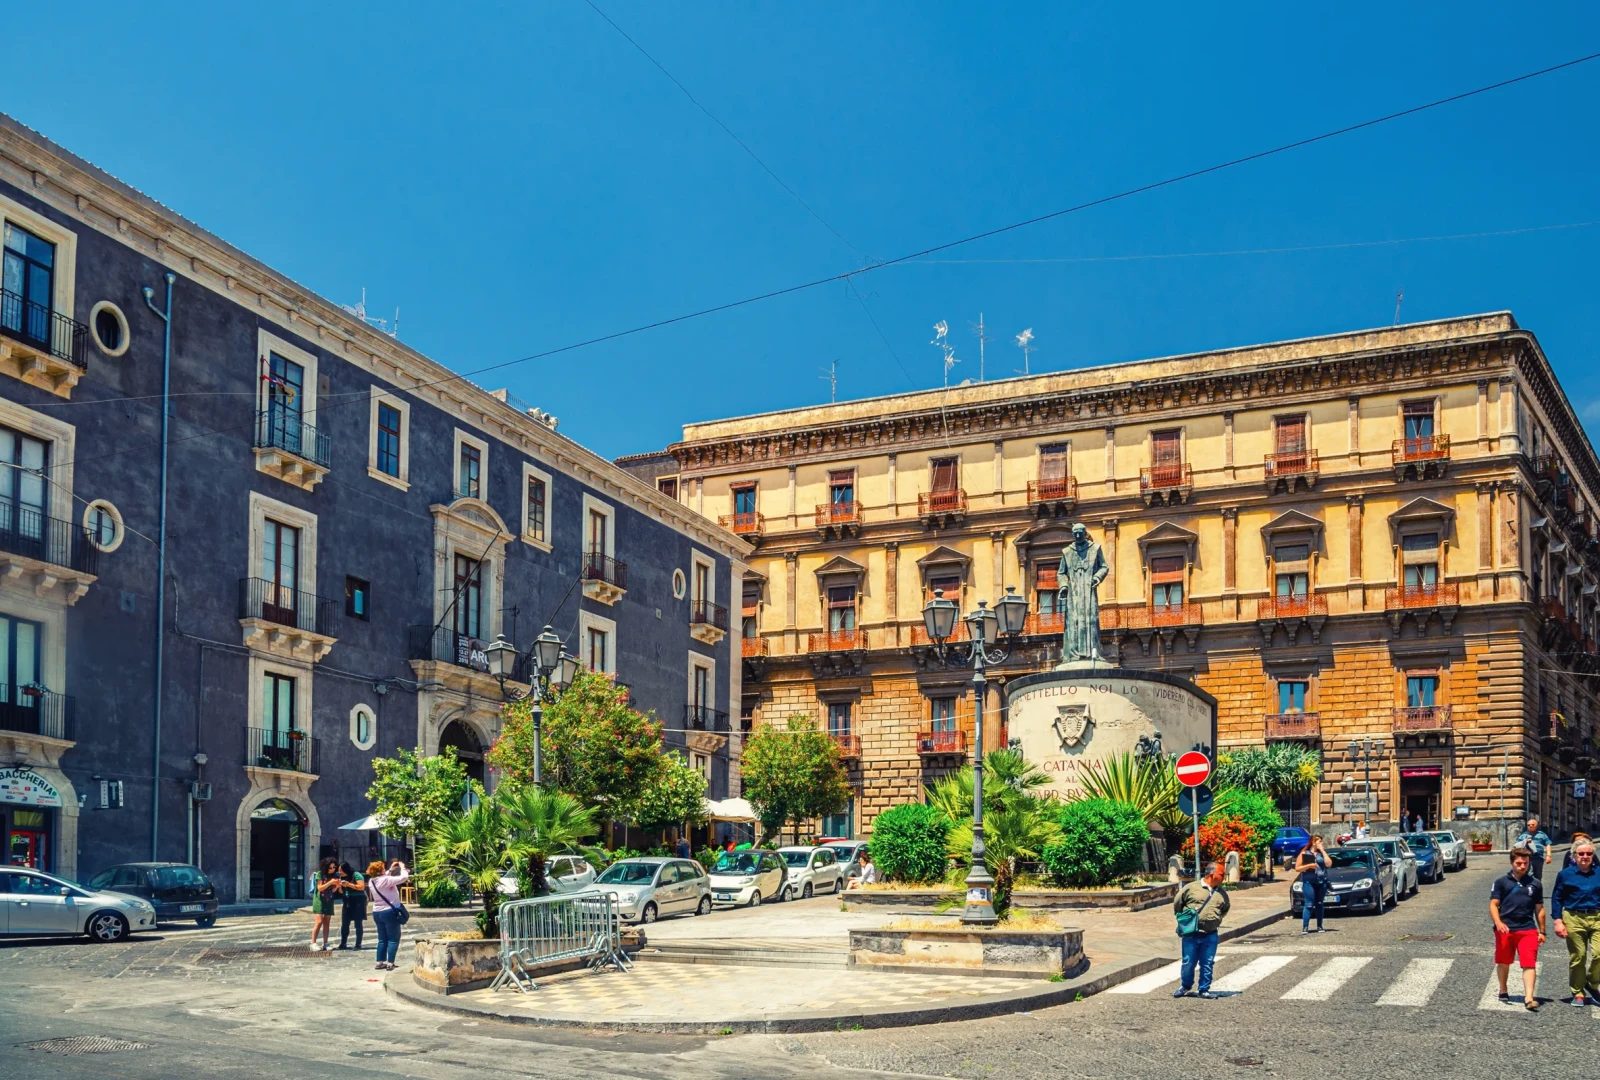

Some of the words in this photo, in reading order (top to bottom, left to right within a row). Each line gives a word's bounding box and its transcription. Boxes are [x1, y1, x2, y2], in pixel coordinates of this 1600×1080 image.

[1089, 684, 1113, 694] NOI
[1122, 685, 1139, 695] LO
[1043, 759, 1102, 772] CATANIA
[1064, 775, 1078, 784] AL
[109, 782, 117, 800] T
